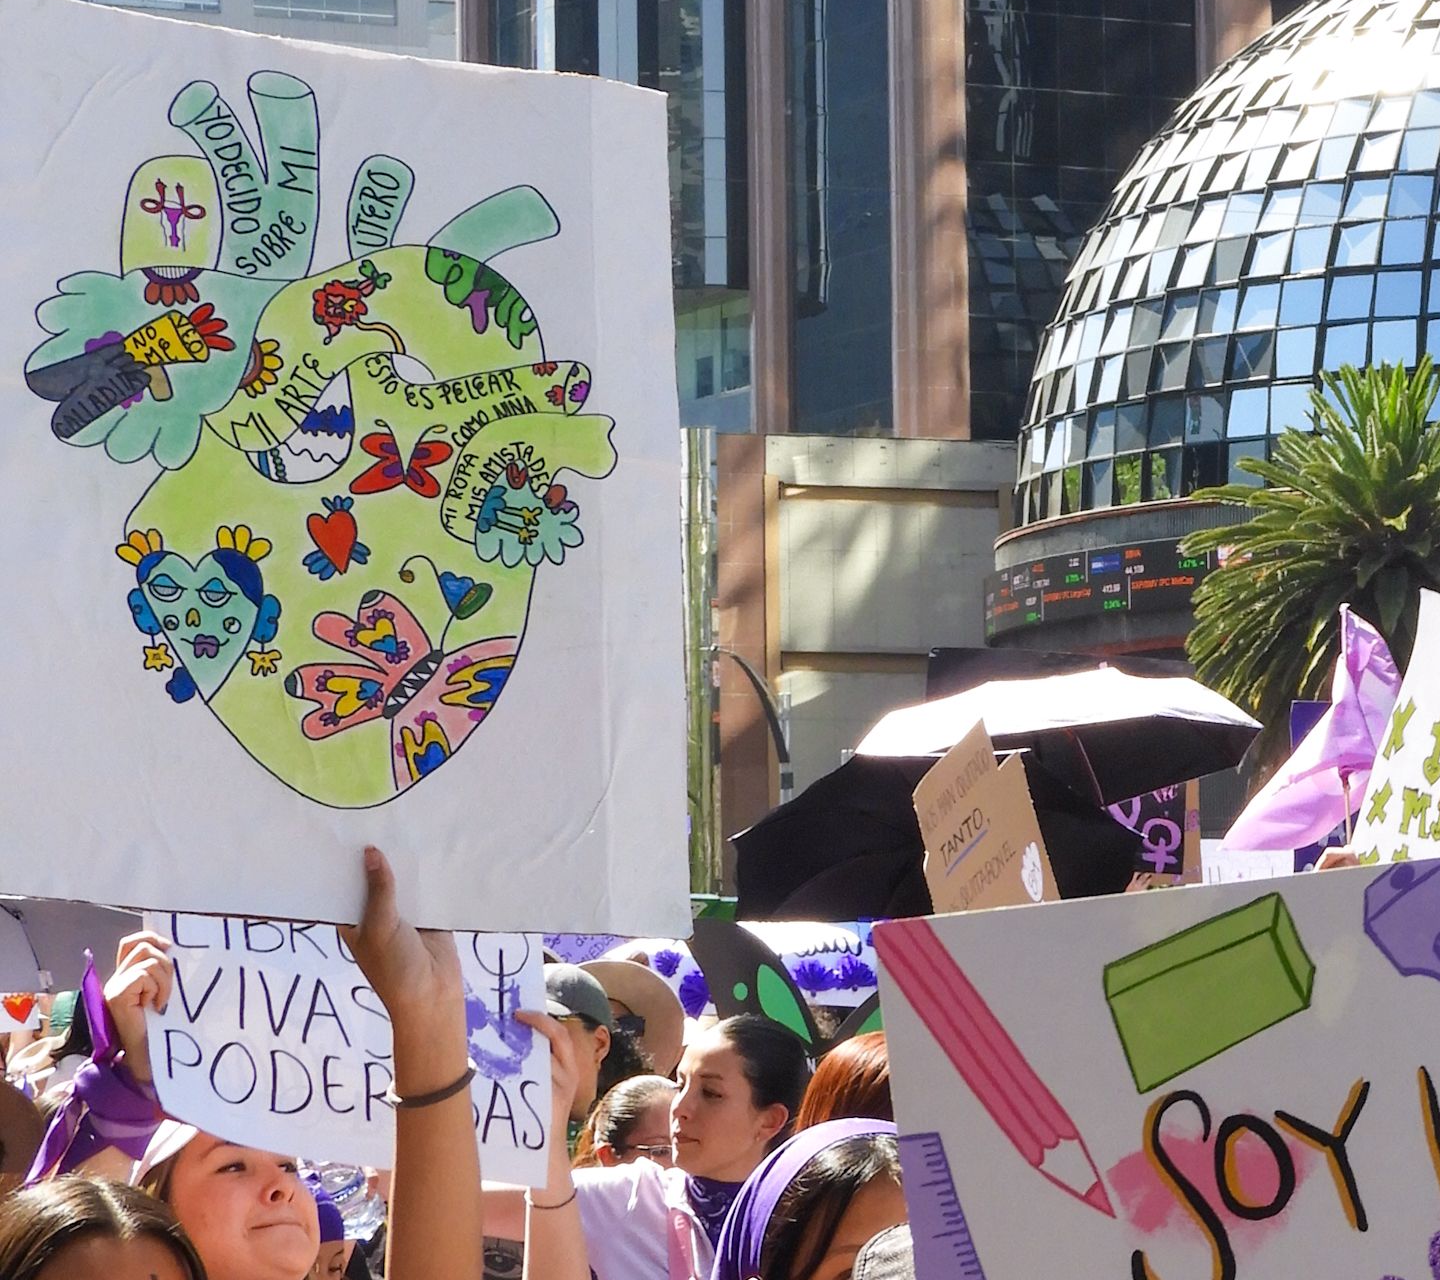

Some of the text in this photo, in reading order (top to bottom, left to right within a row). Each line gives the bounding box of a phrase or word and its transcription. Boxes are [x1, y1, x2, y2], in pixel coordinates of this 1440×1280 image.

[194, 105, 263, 235] YO DECIDO
[235, 145, 320, 275] SOBRE MI
[352, 169, 402, 249] ÚTERO
[132, 325, 158, 350] NO
[437, 368, 523, 405] PELEAR
[231, 412, 282, 449] MI
[451, 409, 490, 448] COMO
[447, 452, 480, 501] ROPA
[465, 486, 489, 522] MIS
